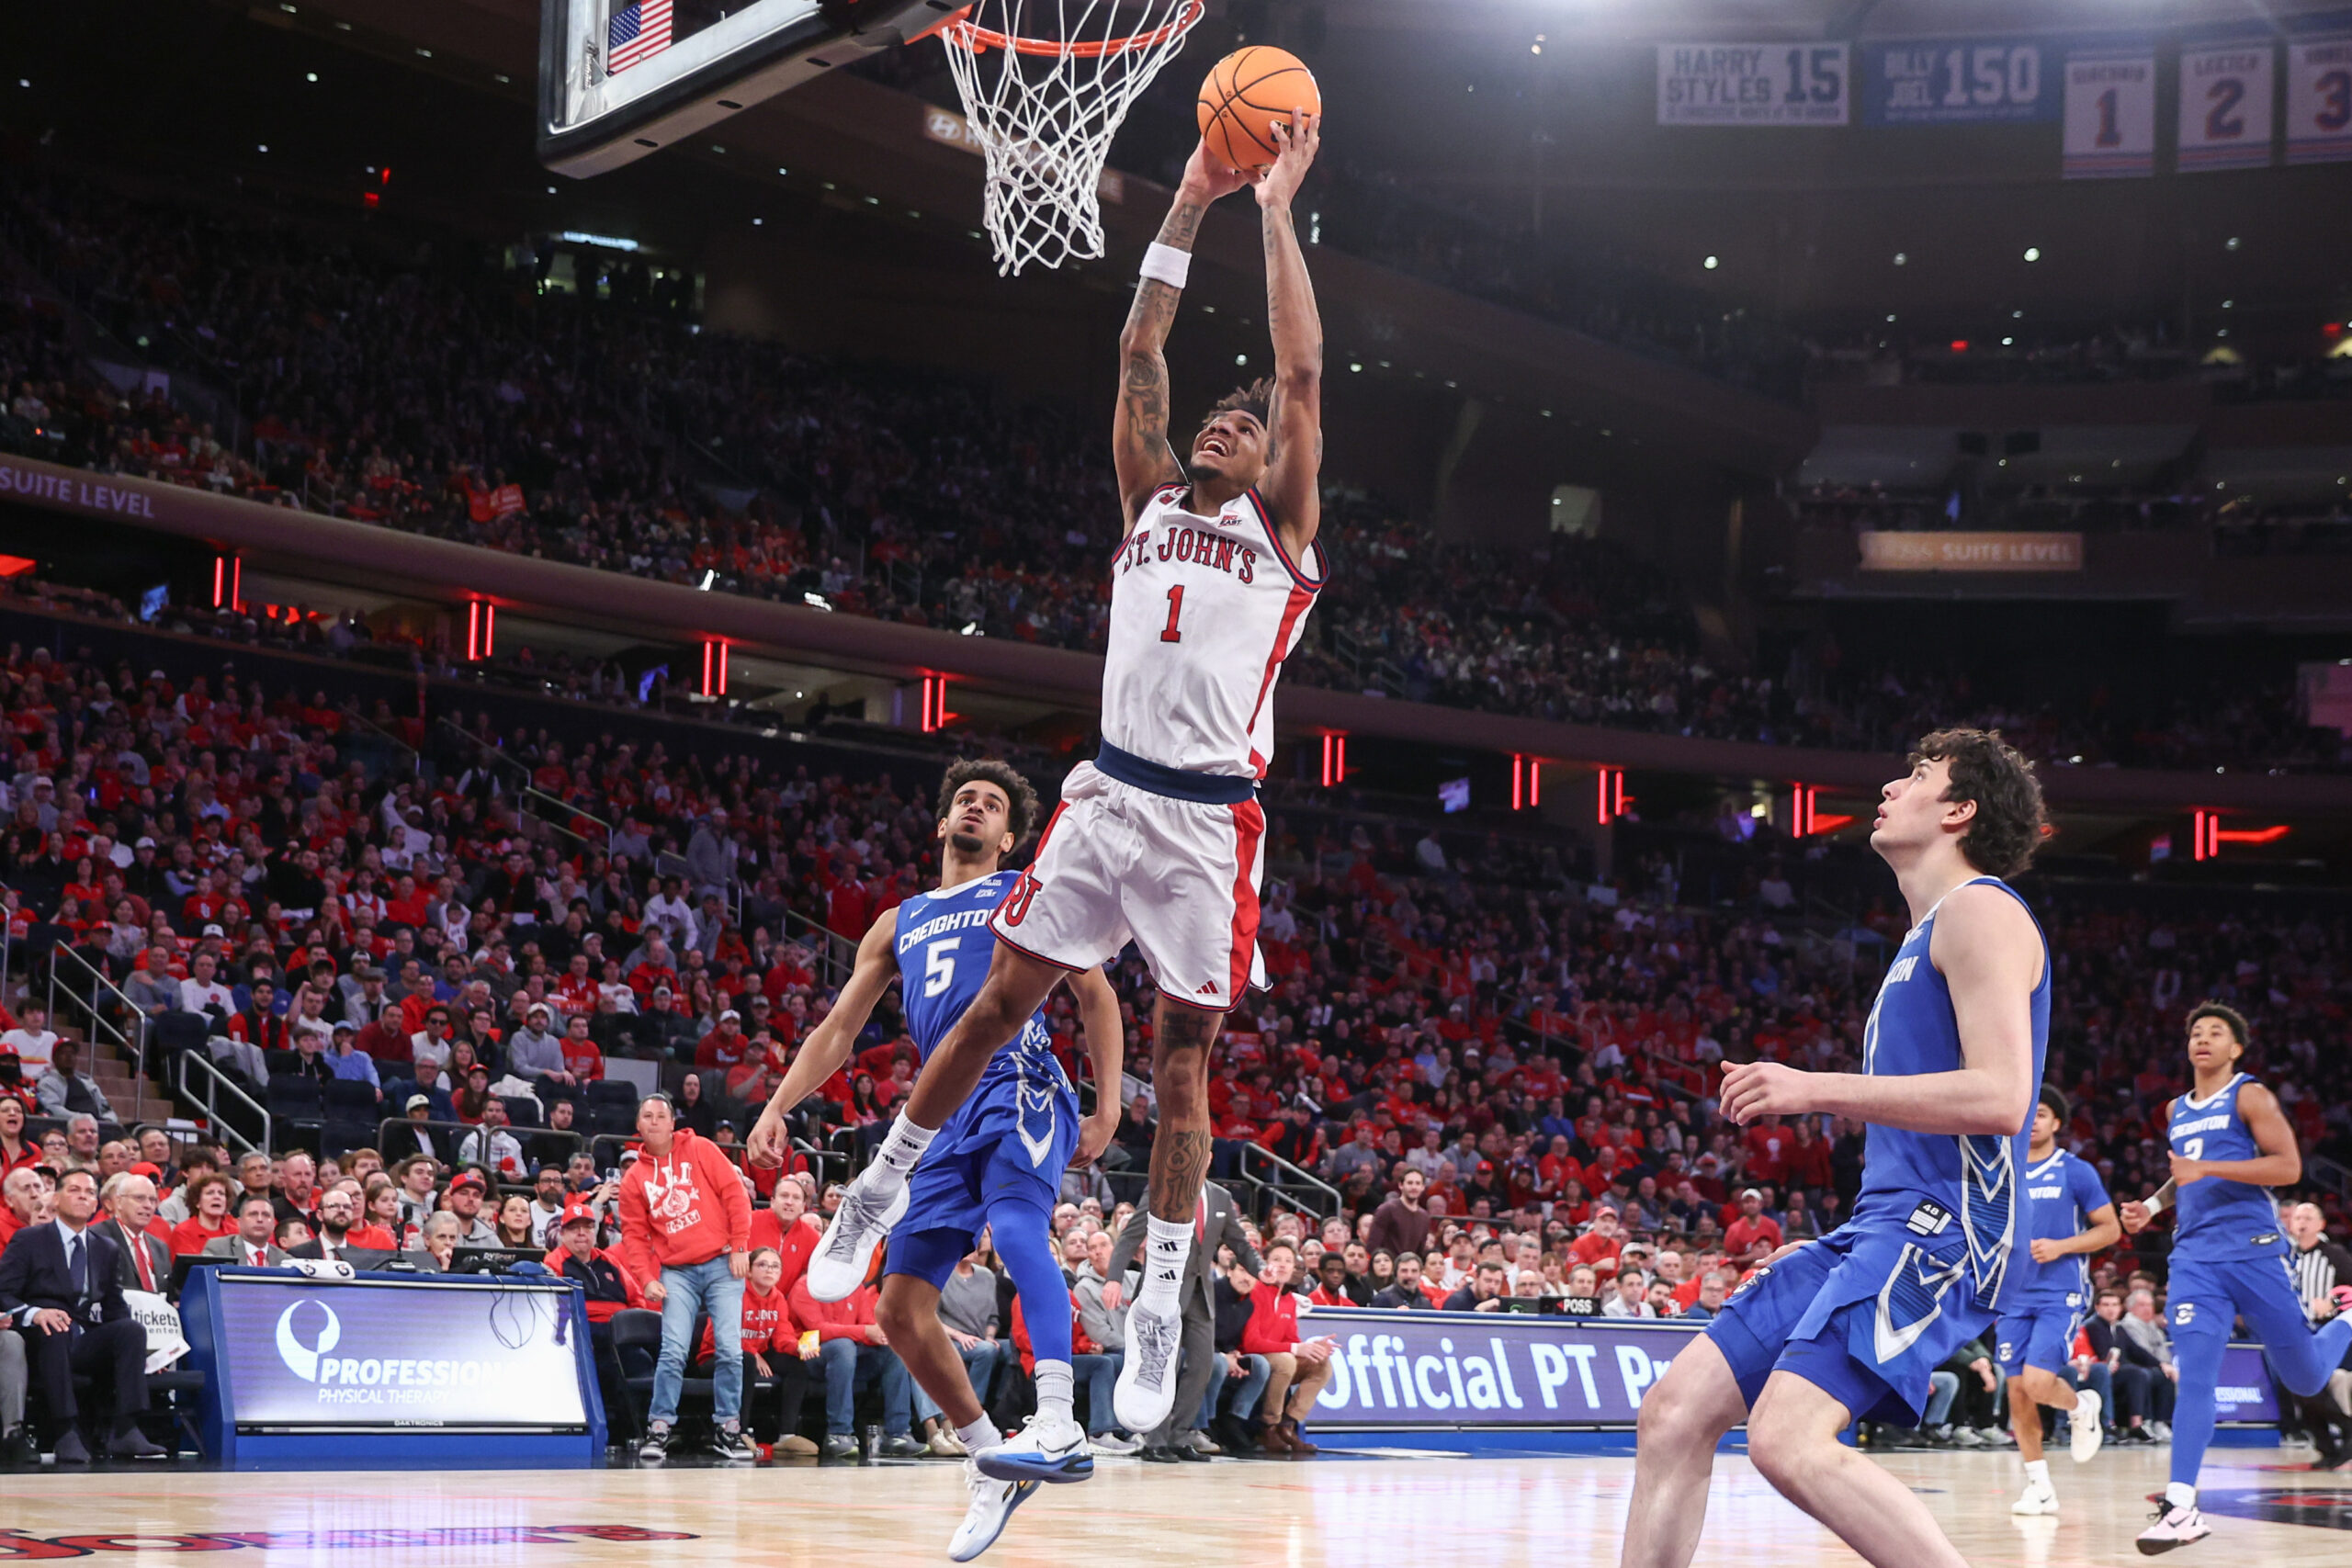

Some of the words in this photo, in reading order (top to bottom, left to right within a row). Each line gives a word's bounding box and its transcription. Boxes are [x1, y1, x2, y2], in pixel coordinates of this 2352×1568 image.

[1674, 49, 1762, 75] HARRY
[1785, 49, 1840, 103] 15
[1943, 46, 2041, 106] 150
[1666, 77, 1770, 103] STYLES
[2205, 78, 2246, 141] 2
[2314, 70, 2352, 133] 3
[2096, 88, 2121, 148] 1
[0, 467, 72, 502] SUITE
[80, 482, 155, 518] LEVEL
[1219, 519, 1242, 527] EAST
[1123, 530, 1151, 576] ST.
[1158, 527, 1257, 584] JOHN'S
[1941, 542, 2002, 562] SUITE
[2008, 542, 2074, 562] LEVEL
[1160, 584, 1185, 643] 1
[924, 937, 962, 998] 5
[134, 1309, 178, 1327] tickets
[1563, 1298, 1592, 1314] POSS
[317, 1388, 384, 1404] PHYSICAL
[387, 1389, 450, 1404] THERAPY
[320, 1358, 504, 1386] PROFESSION
[1307, 1334, 1524, 1410] Official
[1530, 1343, 1601, 1409] PT
[1614, 1345, 1674, 1409] Pr
[394, 1418, 444, 1427] DAKTRONICS
